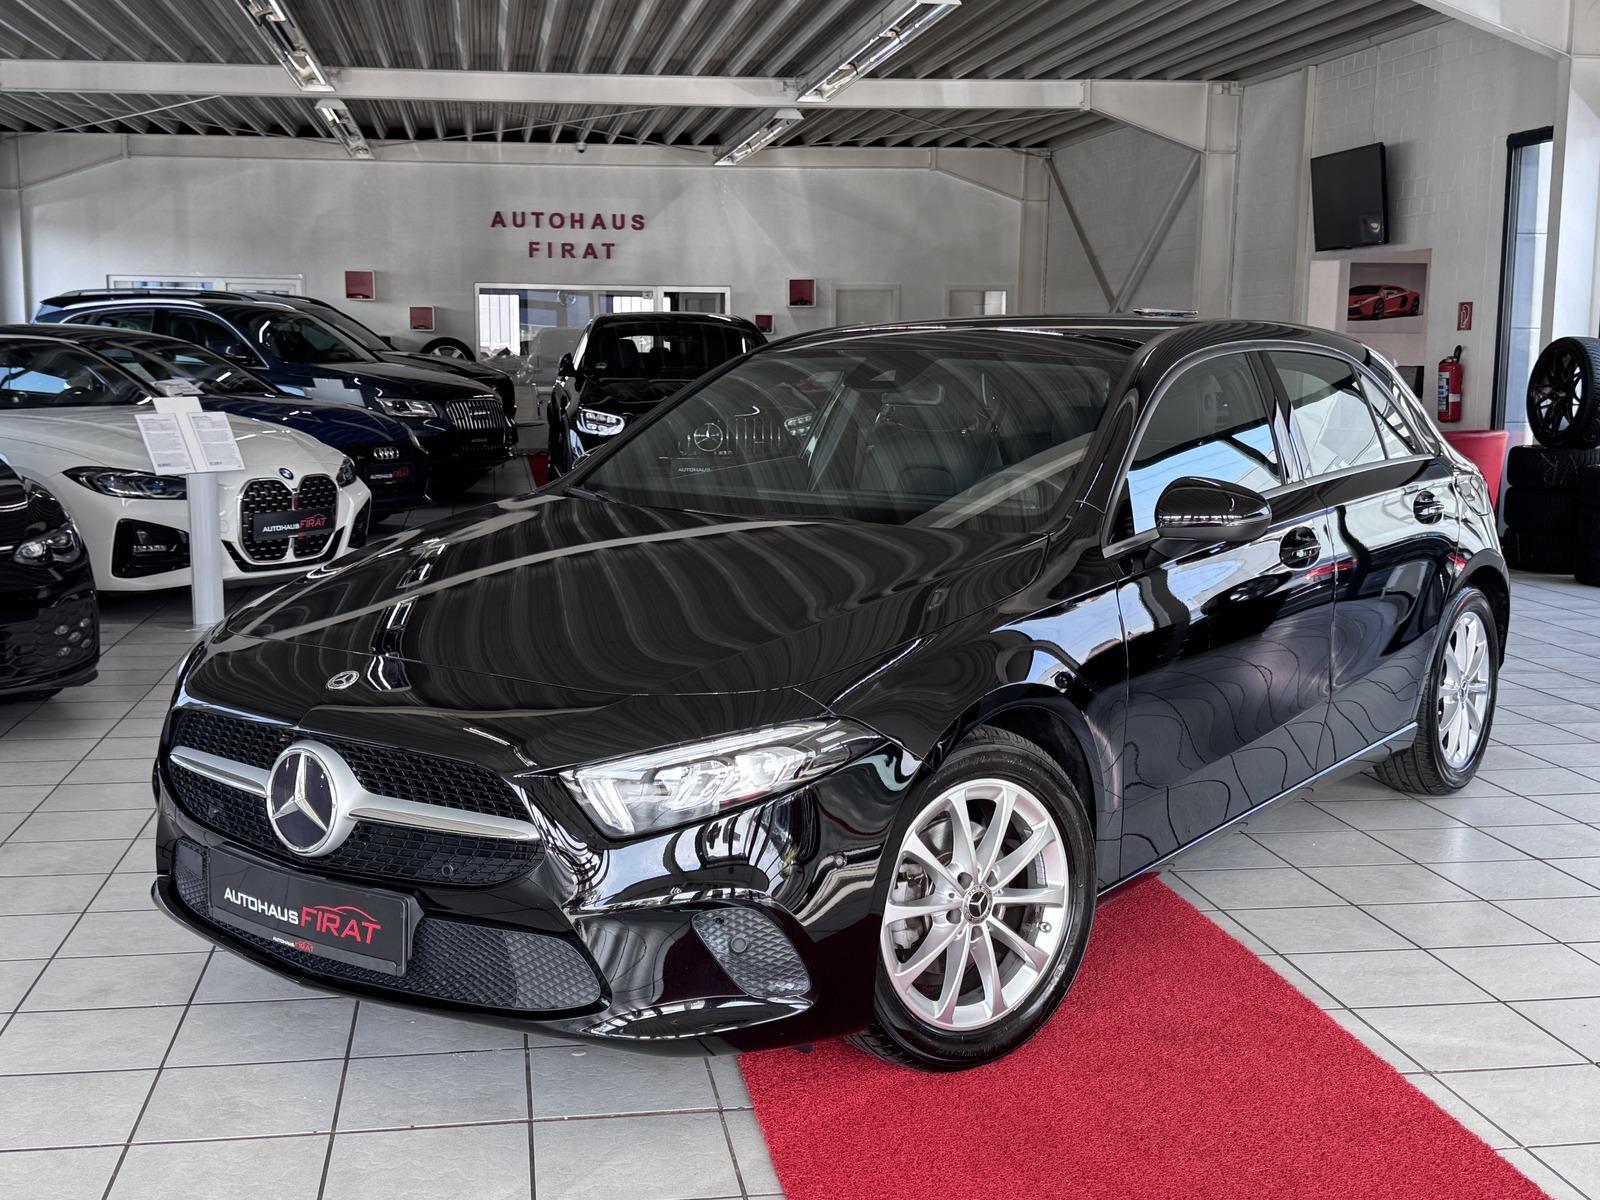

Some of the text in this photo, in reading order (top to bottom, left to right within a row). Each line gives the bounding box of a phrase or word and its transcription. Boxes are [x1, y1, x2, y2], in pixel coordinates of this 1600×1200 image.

[491, 211, 645, 231] AUTOHAUS
[528, 241, 615, 259] FIRAT
[262, 516, 327, 533] AUTOHAUS FIRAT
[224, 887, 381, 945] AUTOHAUS FIRAT
